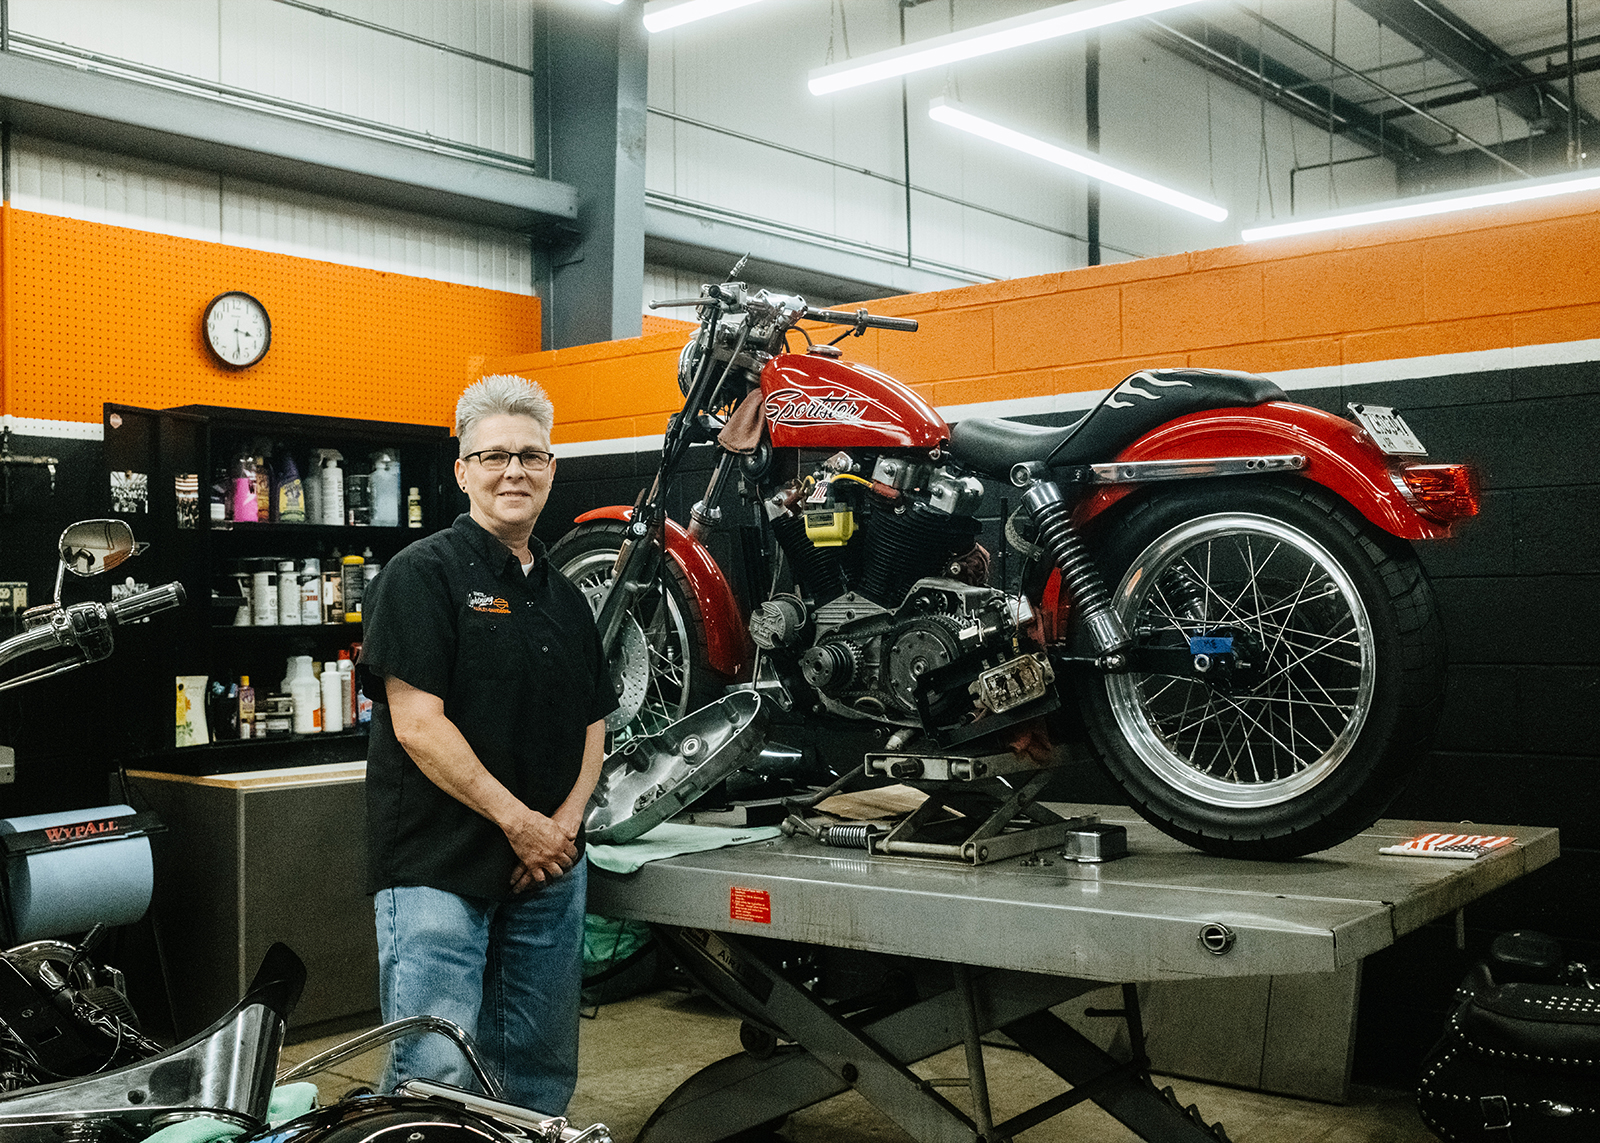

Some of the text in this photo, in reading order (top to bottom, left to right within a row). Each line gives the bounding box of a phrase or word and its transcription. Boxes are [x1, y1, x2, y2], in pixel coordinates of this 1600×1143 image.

[222, 302, 230, 313] 11
[232, 299, 241, 310] 12
[245, 304, 249, 314] 1
[213, 311, 223, 321] 10
[252, 314, 259, 324] 2
[208, 323, 215, 332] 9
[256, 328, 262, 337] 3
[212, 336, 219, 346] 8
[221, 345, 227, 357] 7
[232, 350, 239, 360] 6
[244, 347, 250, 358] 5
[765, 388, 868, 432] Sportster
[45, 821, 118, 842] WYPALL
[717, 949, 737, 968] AIR
